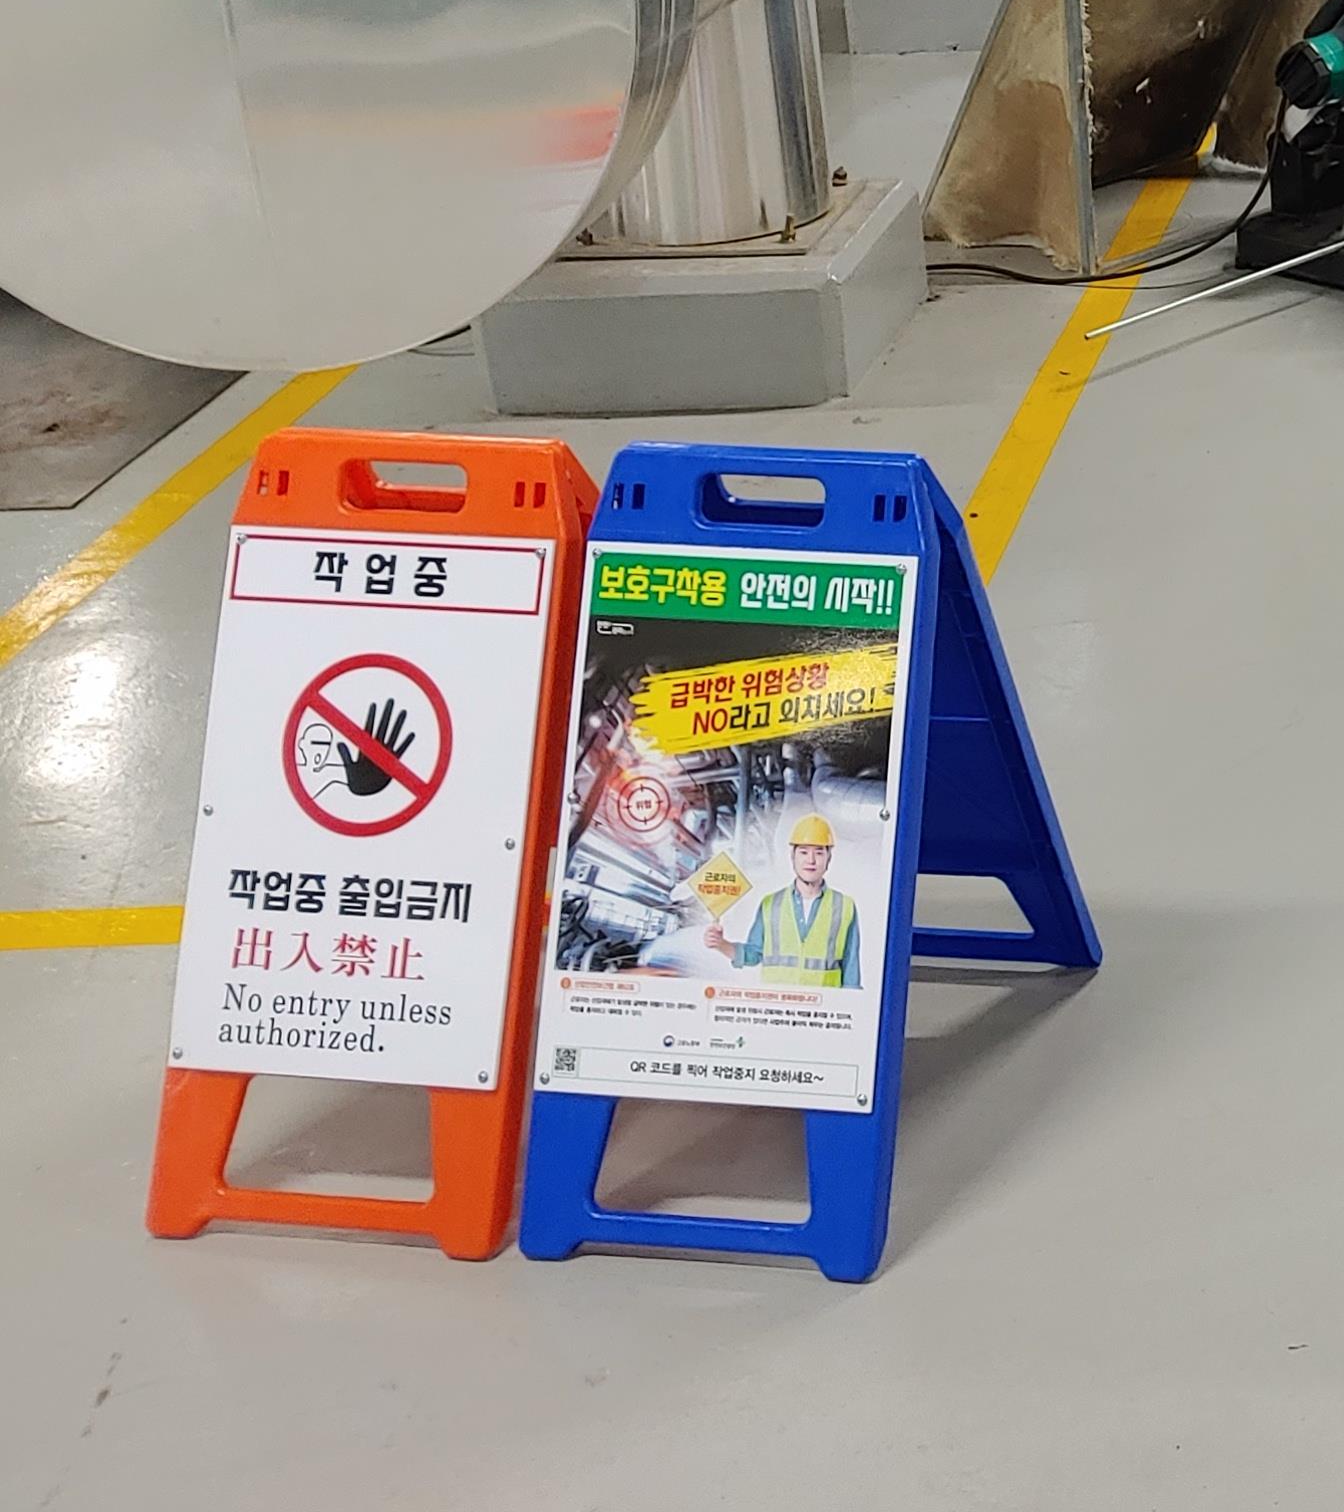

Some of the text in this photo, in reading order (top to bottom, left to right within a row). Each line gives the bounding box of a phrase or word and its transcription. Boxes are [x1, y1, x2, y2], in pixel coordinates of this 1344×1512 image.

[598, 564, 895, 615] 보호구착용 안전의 시작!!
[671, 662, 830, 710] 급박한 위험상황
[692, 687, 876, 736] NO라고 외치세요!
[228, 869, 472, 923] 작업중 출입금지
[231, 928, 425, 980] 出入禁止
[221, 983, 452, 1025] No entry unless
[218, 1017, 386, 1052] authorized.
[630, 1061, 824, 1084] QR 코드를 찍어 작업중지 요청하세요~
